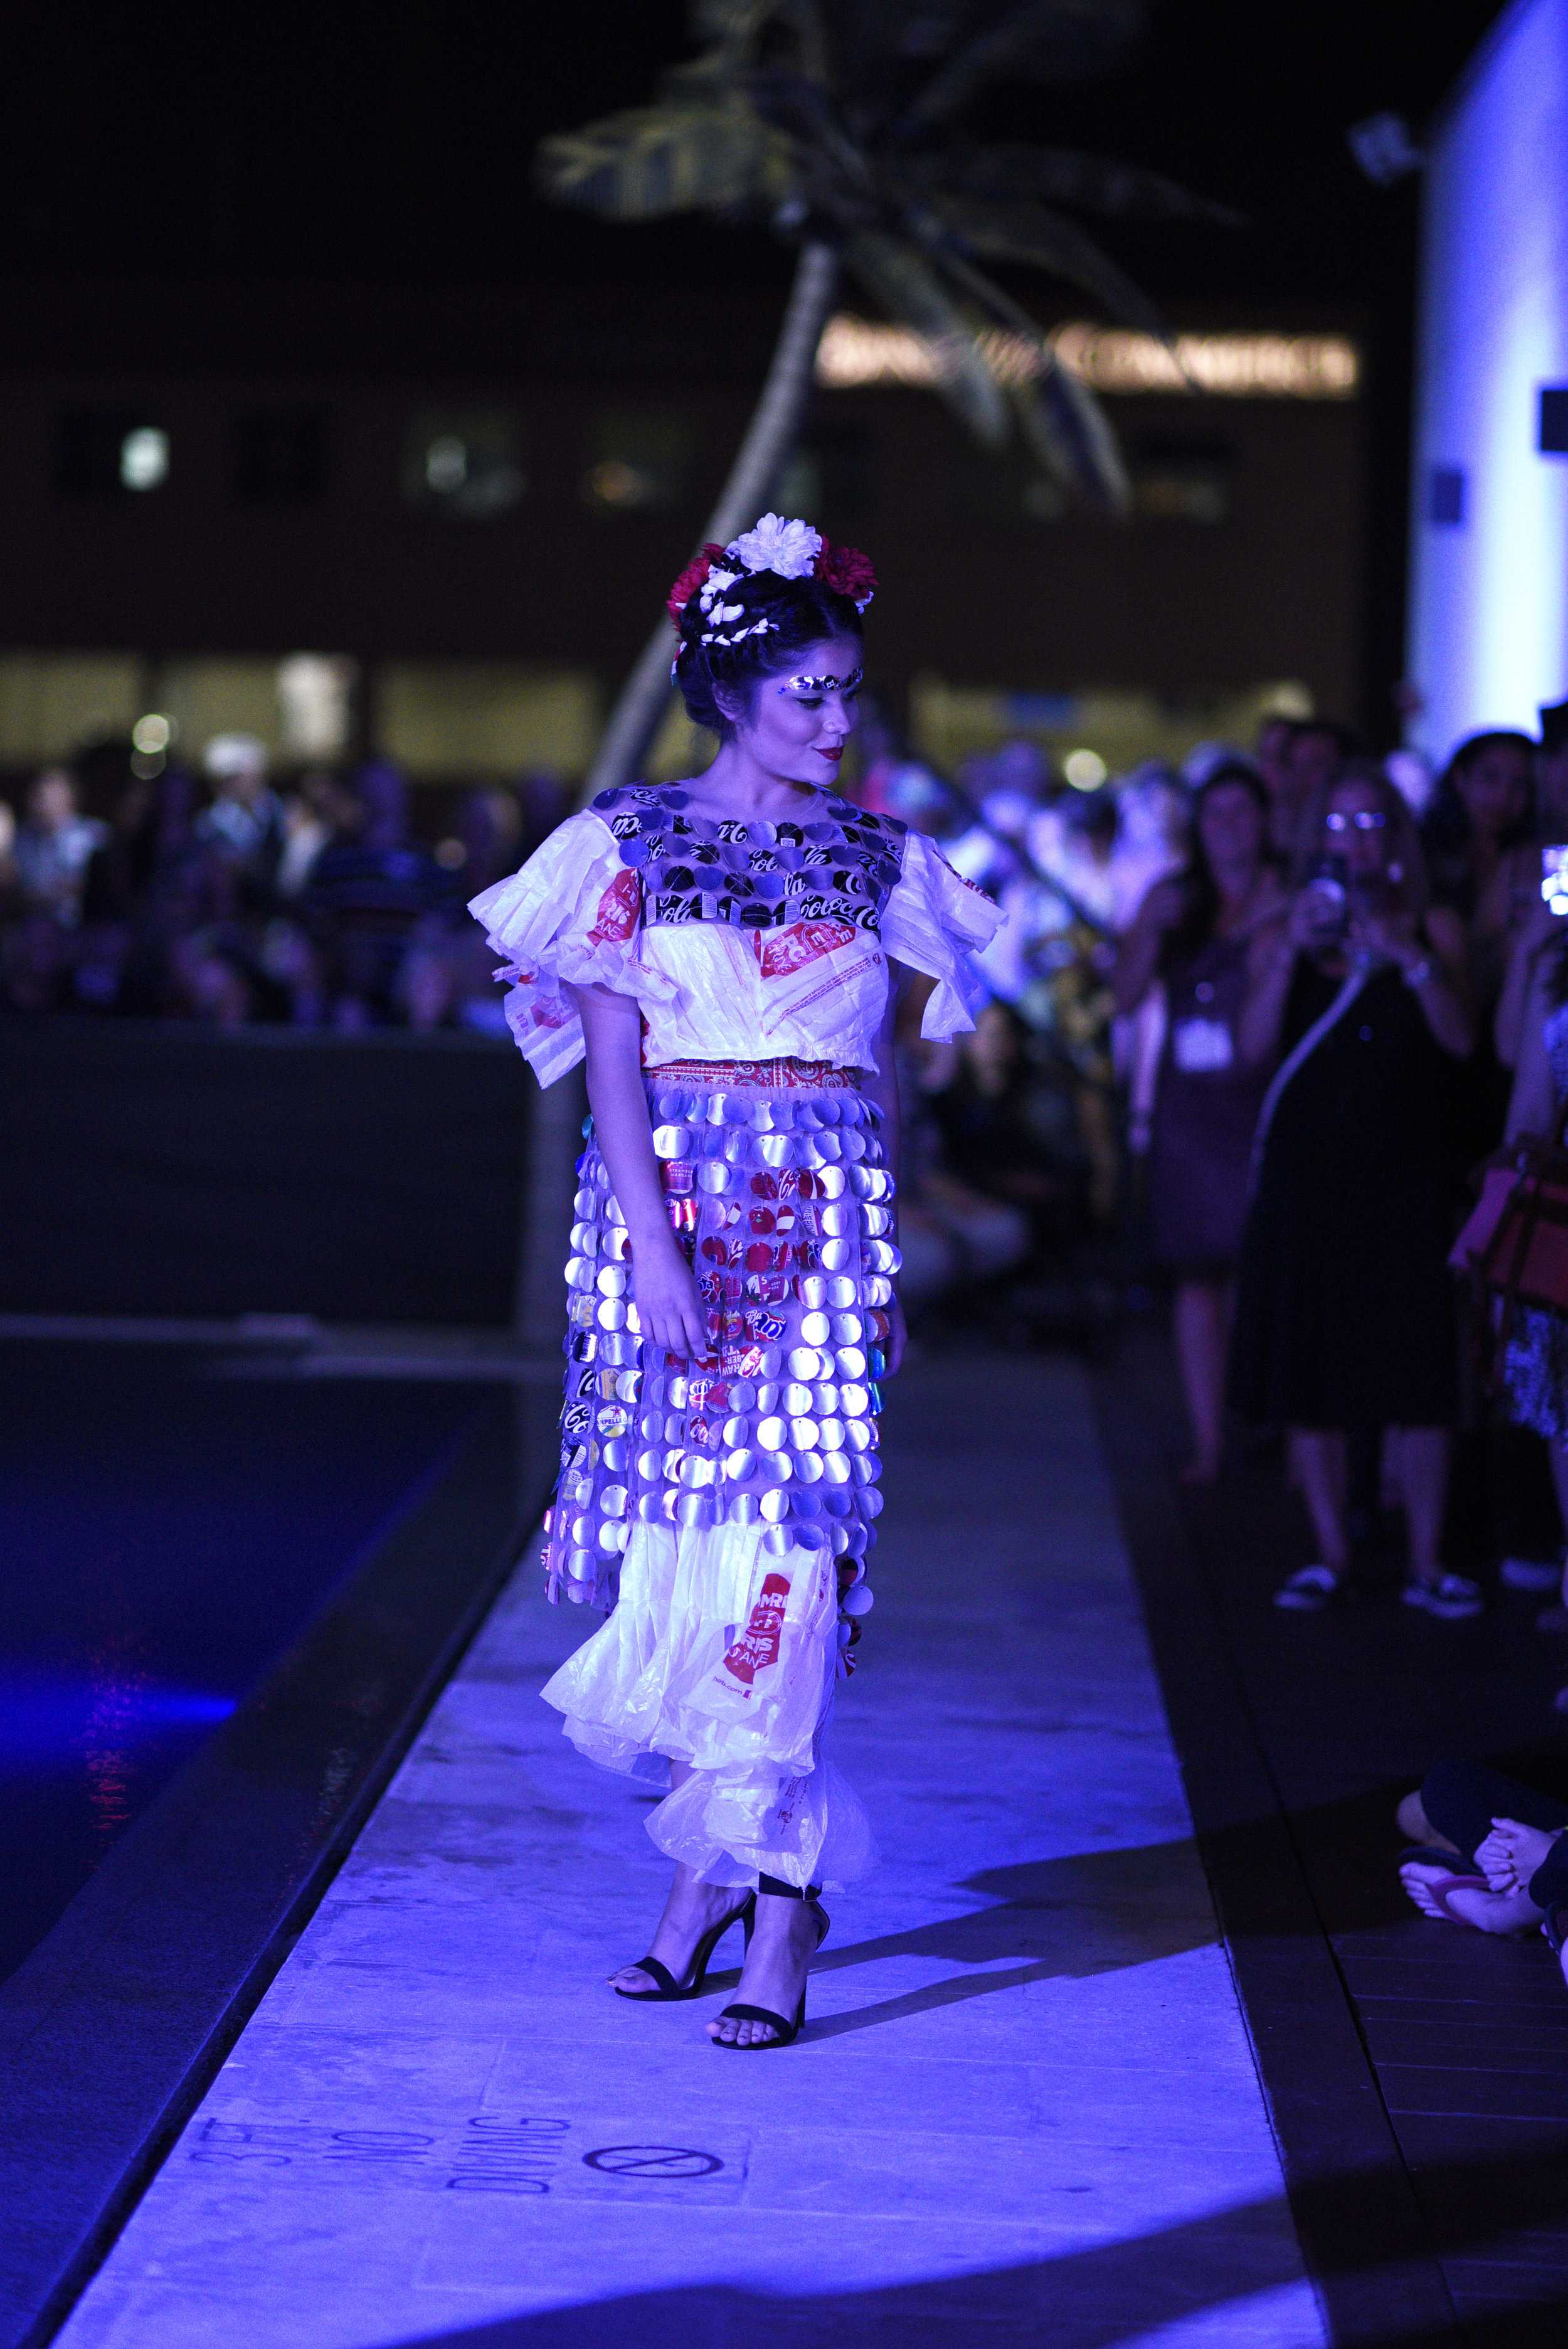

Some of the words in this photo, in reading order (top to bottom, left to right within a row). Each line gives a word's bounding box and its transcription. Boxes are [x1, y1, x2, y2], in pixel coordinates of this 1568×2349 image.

[712, 1675, 743, 1695] heb.com
[322, 2131, 435, 2165] NO
[445, 2116, 573, 2193] DIVING
